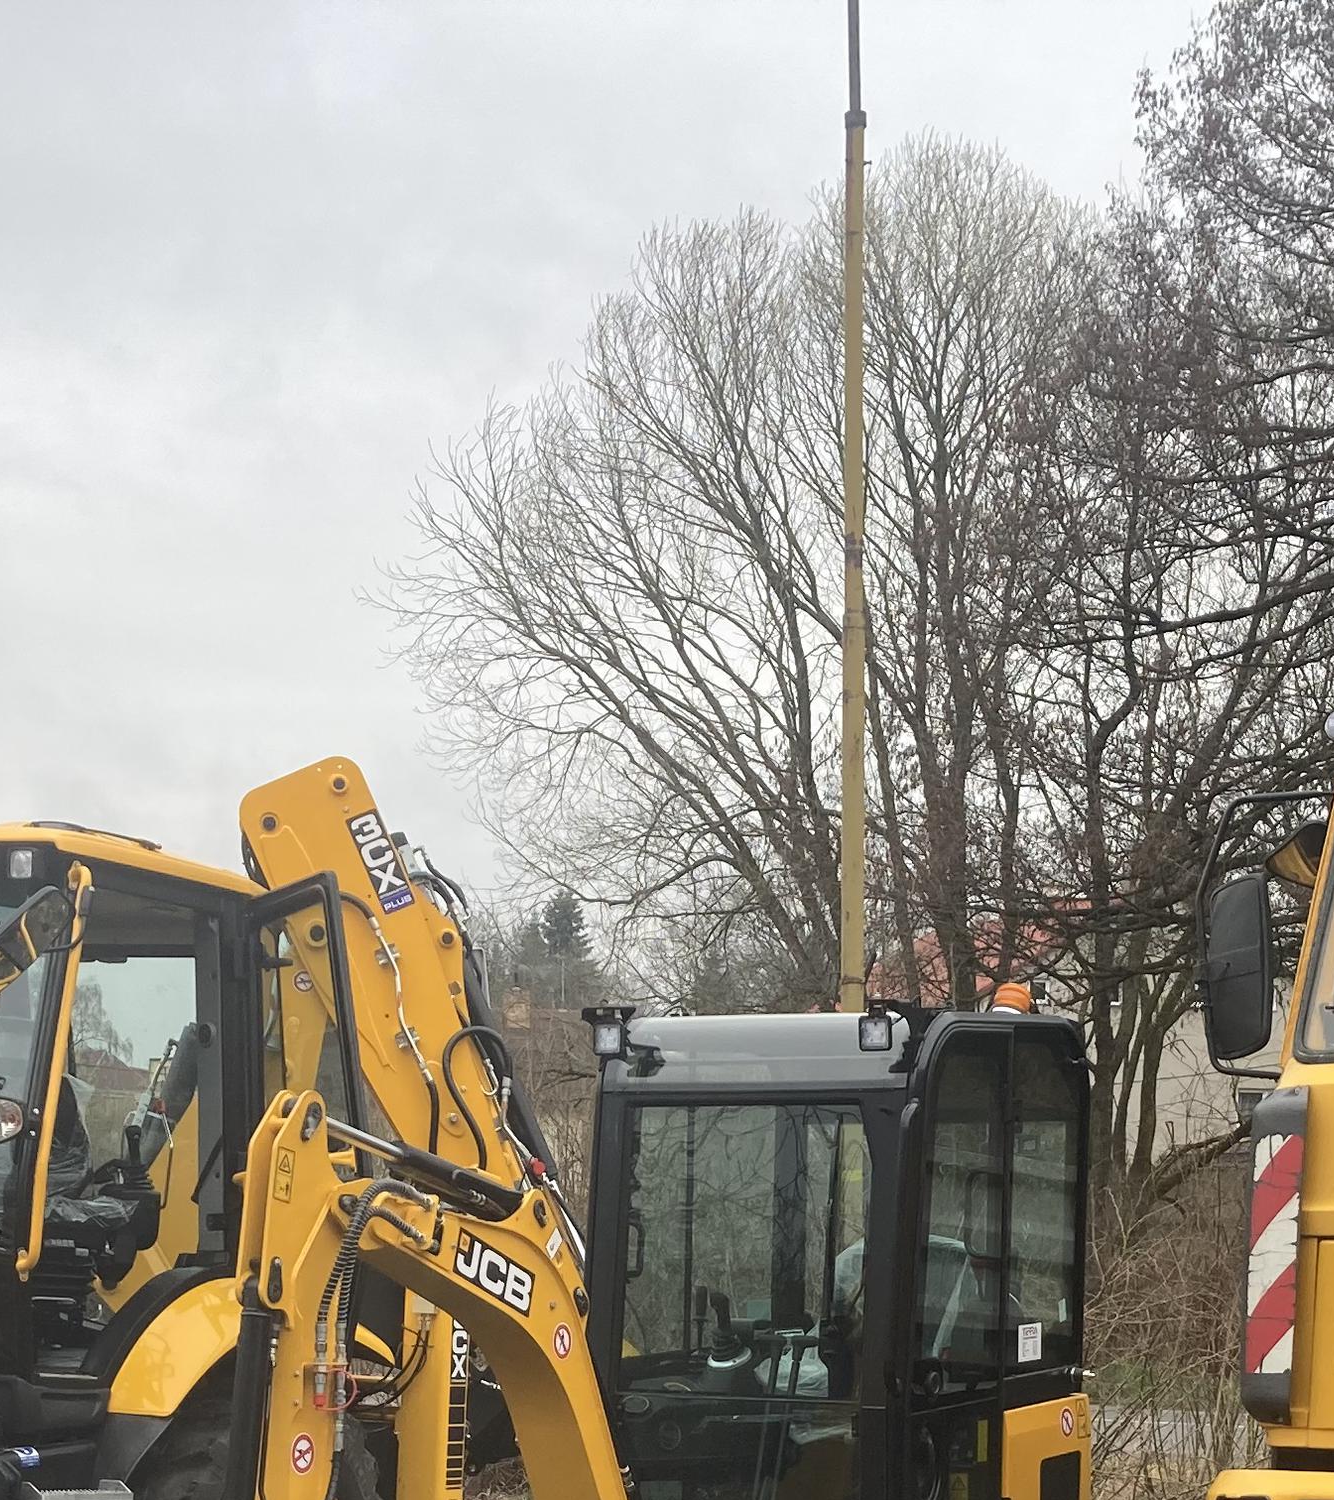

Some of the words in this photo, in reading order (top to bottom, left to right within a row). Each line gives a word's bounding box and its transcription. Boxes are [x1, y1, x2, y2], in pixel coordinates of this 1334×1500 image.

[351, 814, 405, 895] 3CX
[384, 895, 412, 911] PLUS
[456, 1241, 531, 1311] JCB
